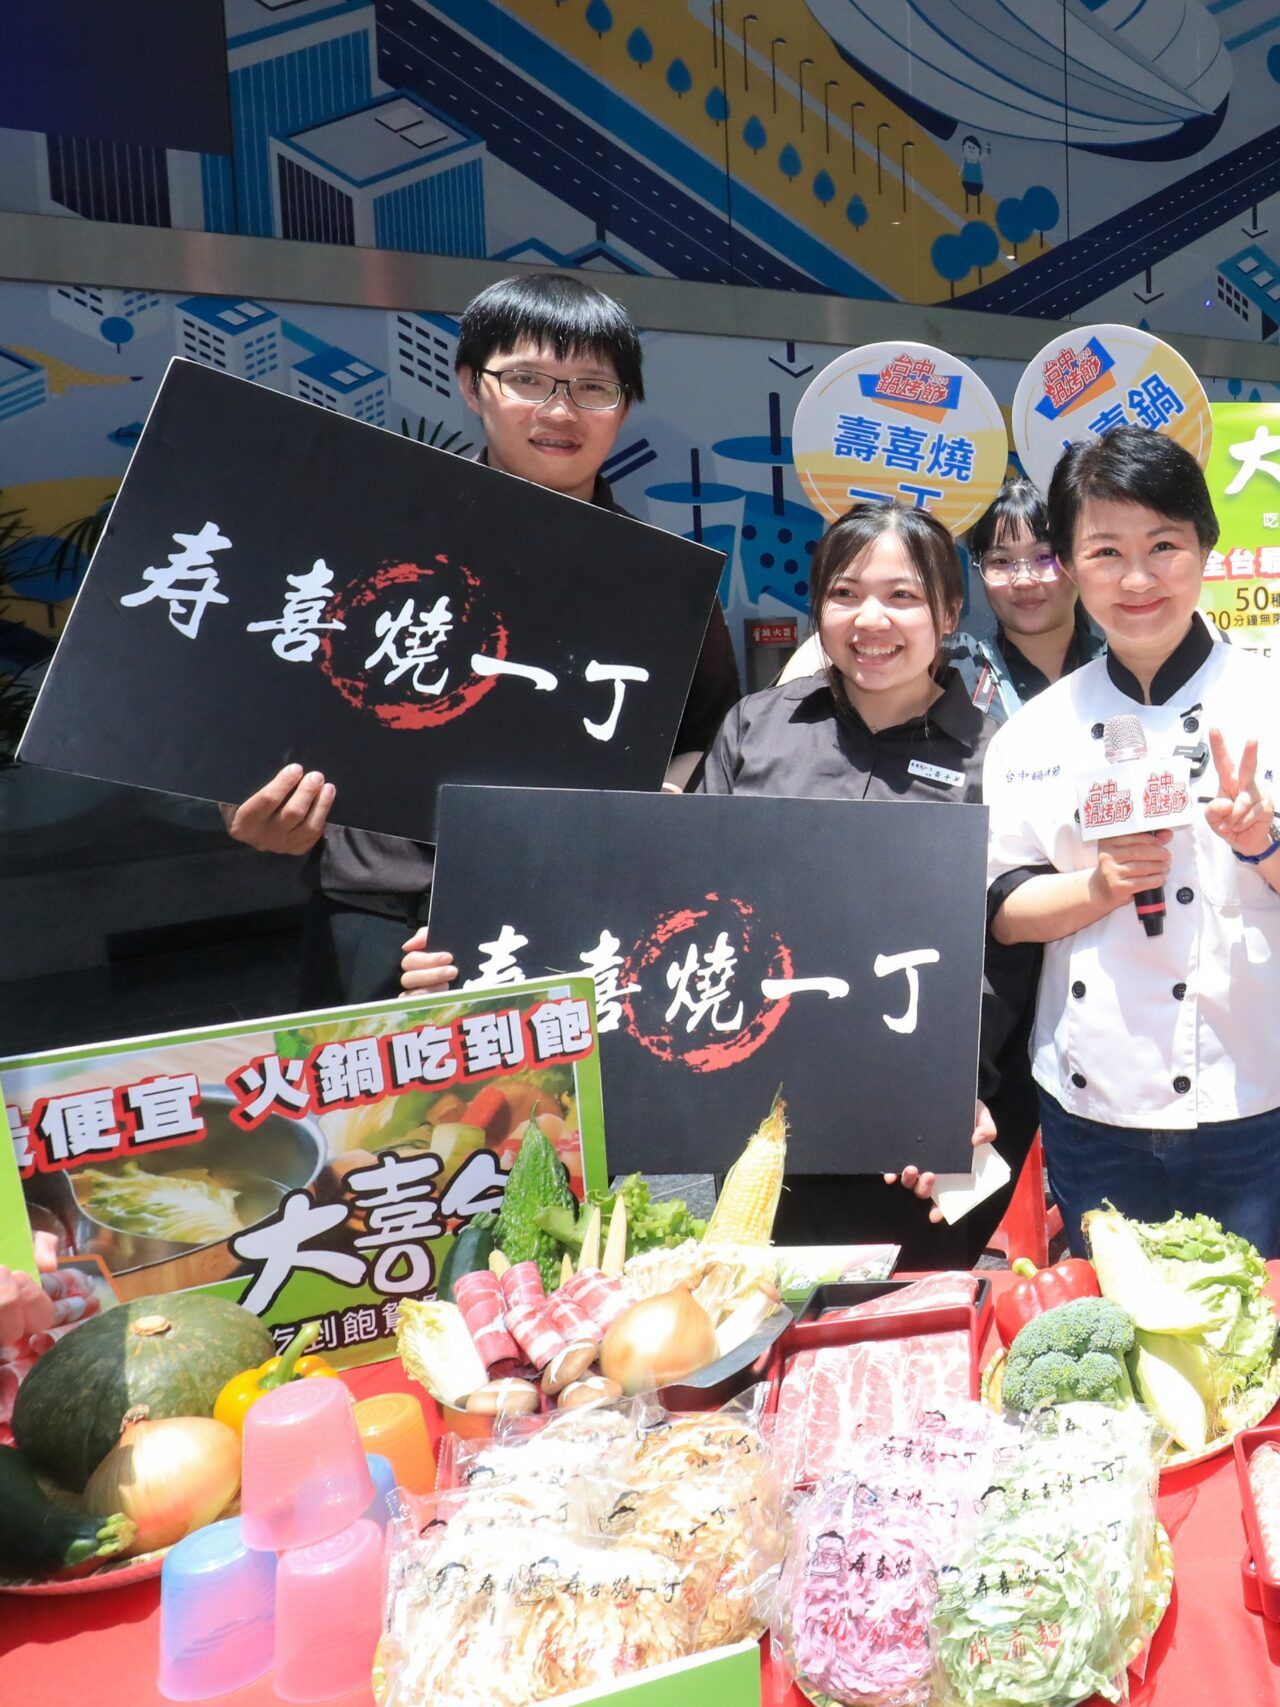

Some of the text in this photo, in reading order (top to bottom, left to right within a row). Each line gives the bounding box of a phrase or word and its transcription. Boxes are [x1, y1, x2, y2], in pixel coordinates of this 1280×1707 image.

[892, 353, 936, 379] 台中
[833, 414, 974, 481] 壽喜燒
[240, 1001, 593, 1117] 火鍋吃到飽
